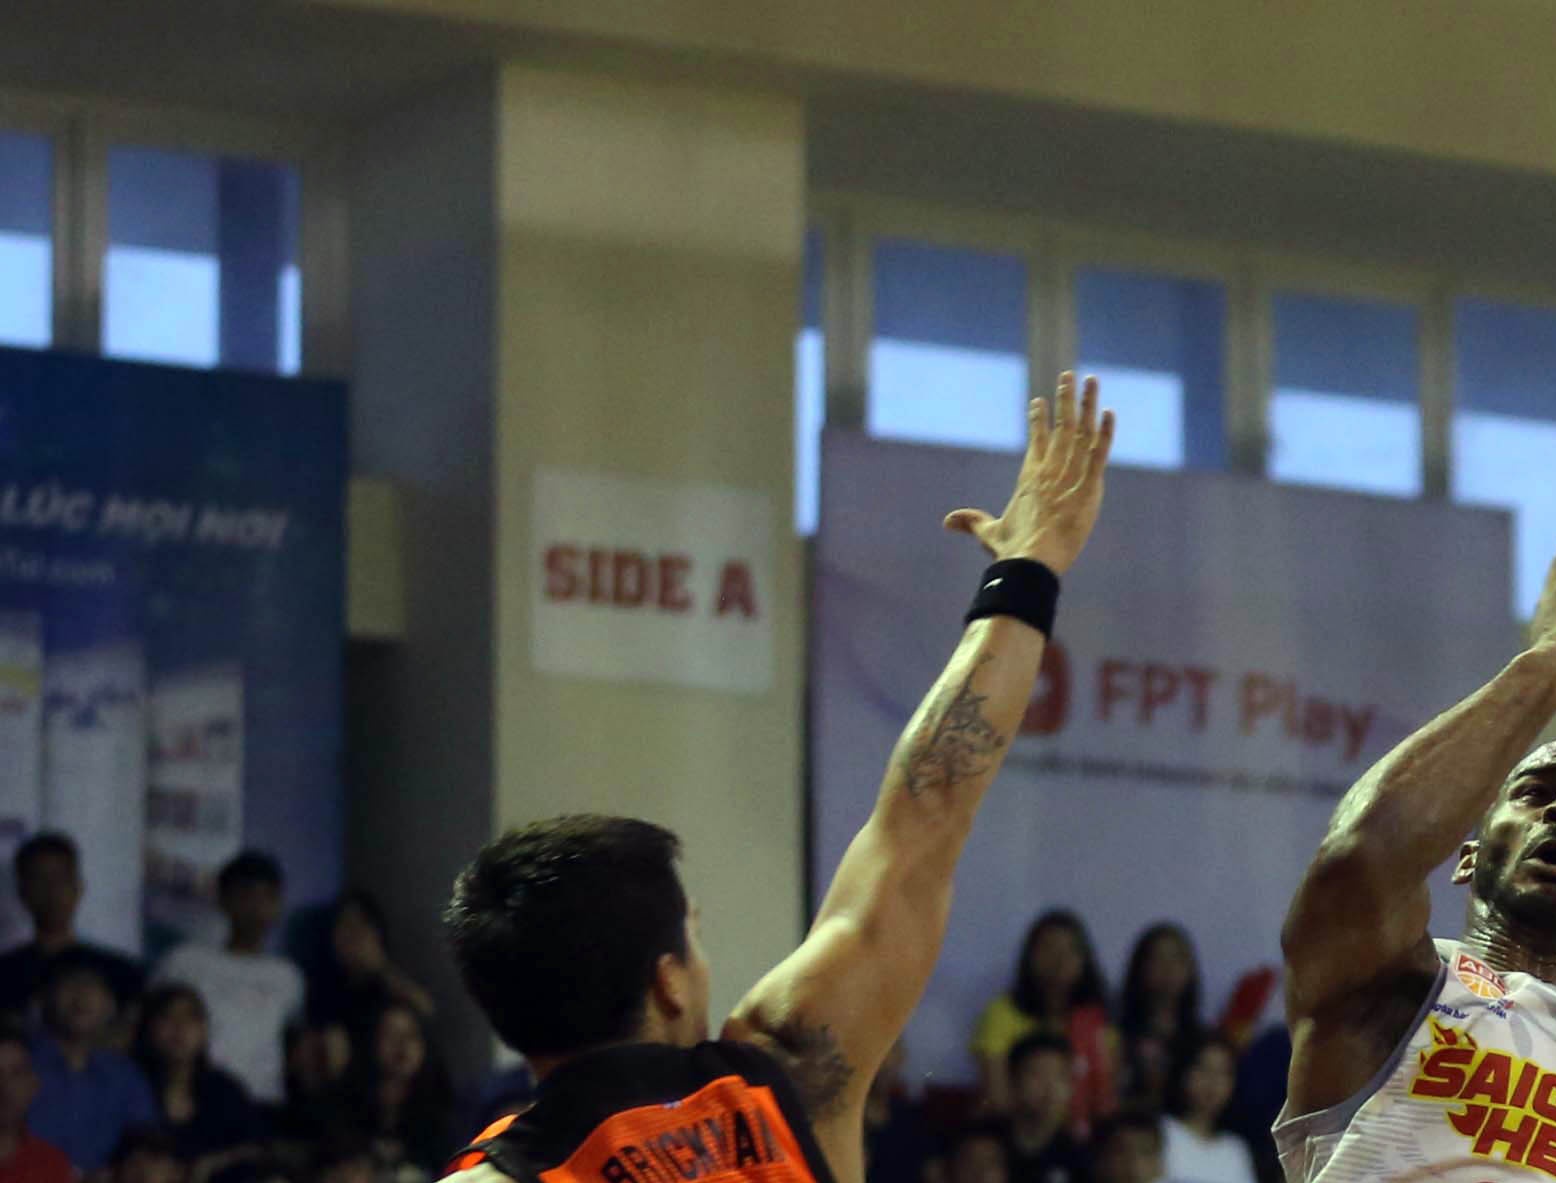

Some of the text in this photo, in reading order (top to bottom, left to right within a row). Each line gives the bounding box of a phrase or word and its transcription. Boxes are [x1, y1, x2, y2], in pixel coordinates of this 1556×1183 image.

[542, 543, 760, 621] SIDE A
[1096, 659, 1381, 762] FPT Play
